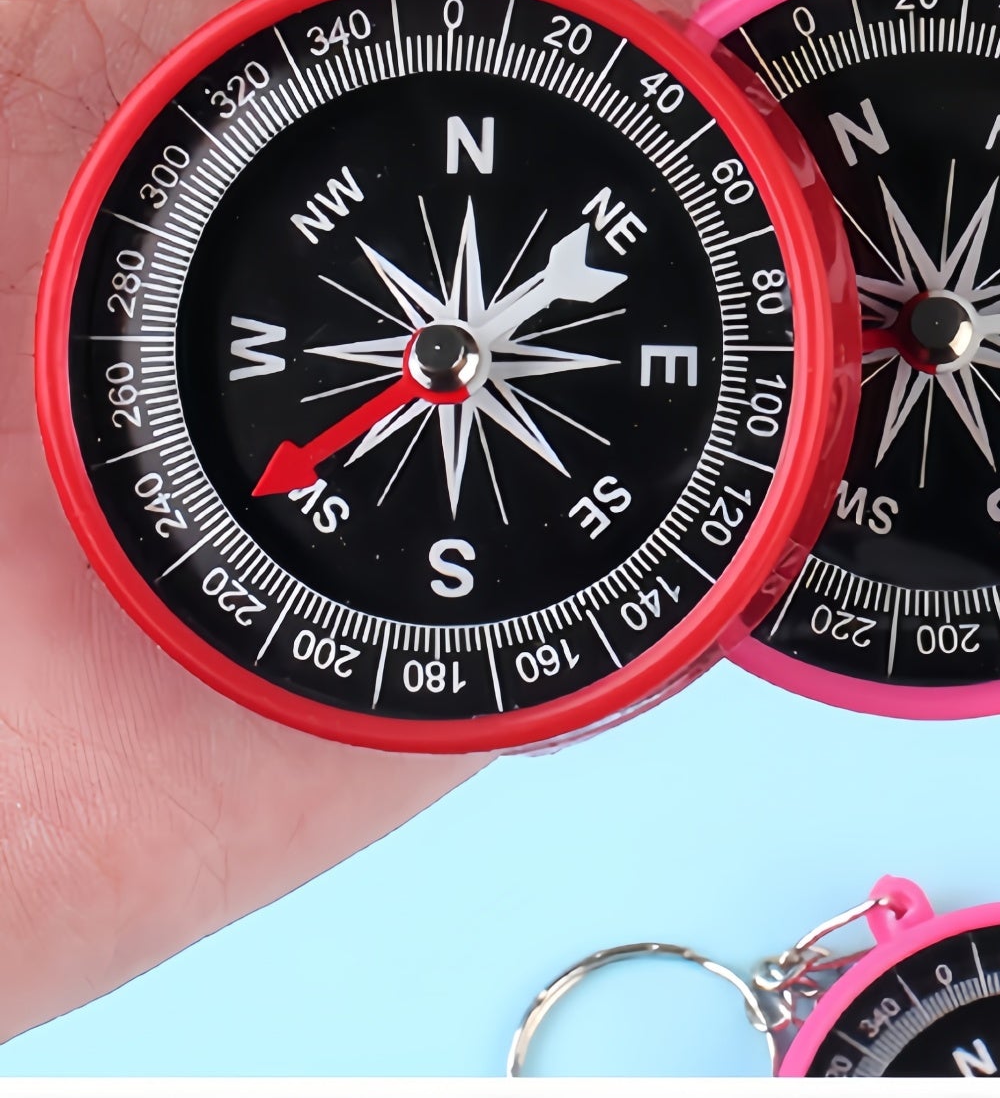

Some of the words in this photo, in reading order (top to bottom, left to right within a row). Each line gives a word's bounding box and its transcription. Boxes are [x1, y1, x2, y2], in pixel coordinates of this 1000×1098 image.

[306, 8, 373, 54] 340
[542, 14, 593, 55] 20
[793, 7, 815, 36] 0
[210, 60, 271, 115] 320
[637, 71, 686, 115] 40
[446, 116, 494, 175] N
[827, 97, 890, 167] N
[139, 144, 192, 210] 300
[710, 159, 755, 207] 60
[289, 165, 366, 245] NW
[581, 186, 648, 256] NE
[107, 248, 145, 319] 280
[751, 268, 785, 316] 80
[228, 315, 287, 382] W
[639, 344, 699, 388] E
[106, 365, 142, 429] 260
[748, 373, 787, 438] 100
[134, 472, 188, 540] 240
[567, 475, 633, 540] SE
[699, 486, 752, 548] 120
[835, 480, 899, 535] SW
[426, 538, 476, 598] S
[201, 566, 267, 626] 220
[618, 574, 682, 634] 140
[292, 628, 362, 679] 200
[810, 604, 877, 648] 220
[917, 623, 982, 655] 200
[403, 660, 466, 694] 180
[516, 637, 580, 684] 160
[934, 964, 953, 986] 0
[858, 997, 901, 1040] 340
[952, 1037, 998, 1077] N
